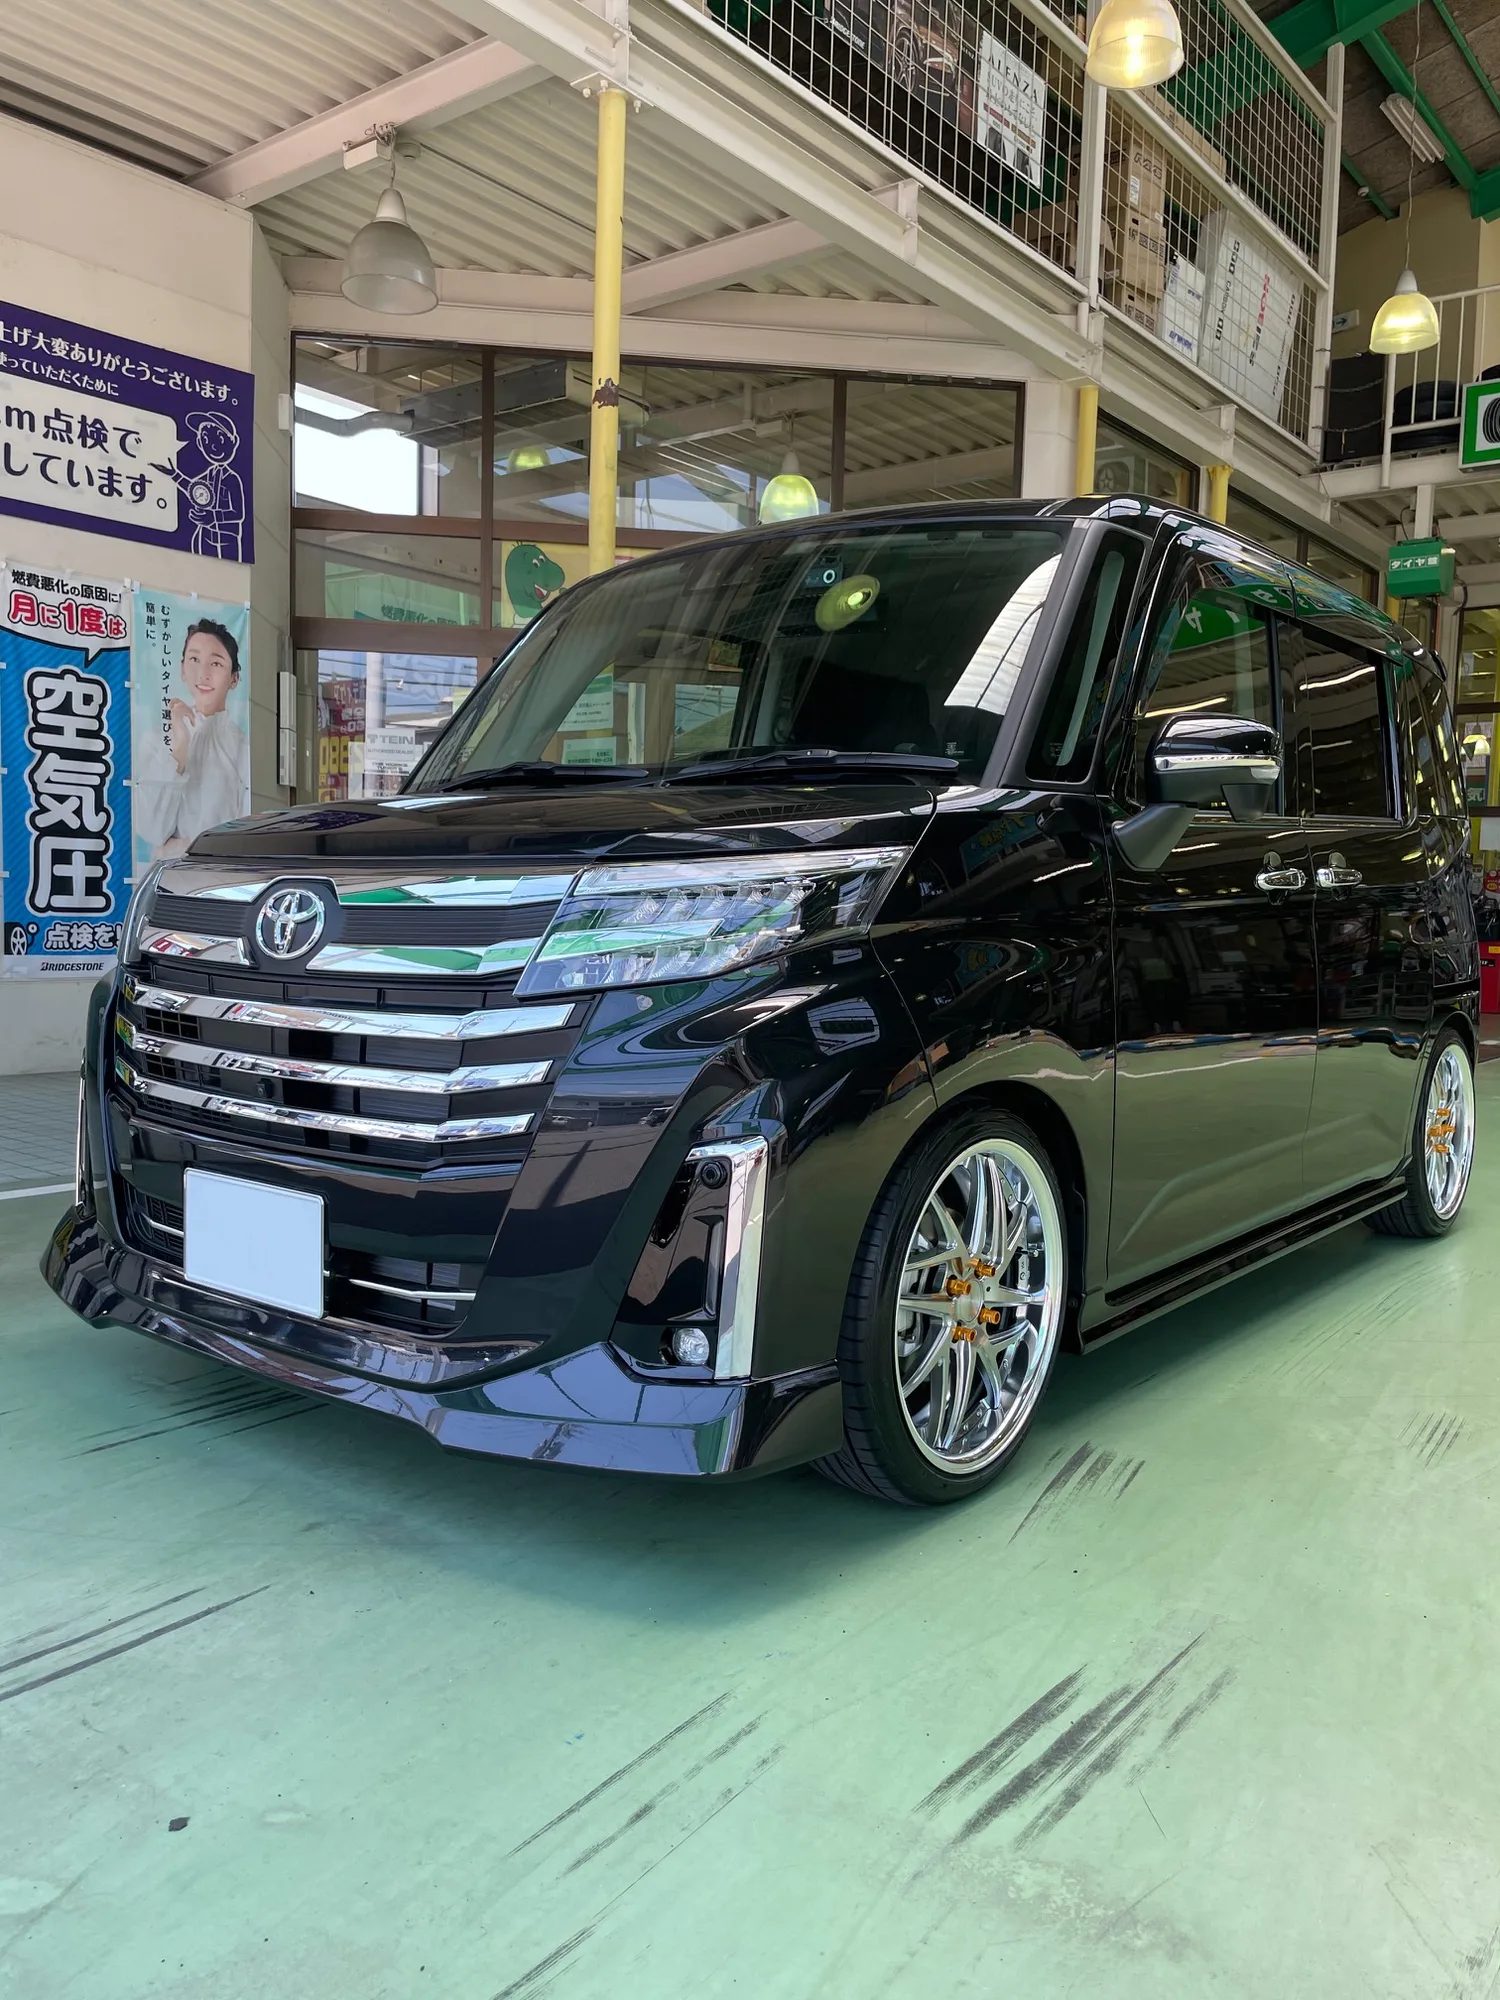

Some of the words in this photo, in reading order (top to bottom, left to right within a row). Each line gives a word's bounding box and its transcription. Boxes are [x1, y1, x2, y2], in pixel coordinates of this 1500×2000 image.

[830, 18, 865, 49] BRIDGETONE
[0, 321, 239, 406] 上げ大変ありがとうございます。
[0, 405, 142, 458] m点検で
[4, 442, 167, 509] しています。
[12, 569, 121, 603] 燃費悪化の原因に!
[10, 592, 125, 637] 月に1度は
[145, 602, 157, 647] 簡単に。
[161, 605, 173, 752] むずかしいタイヤ選びを、
[30, 671, 108, 911] 空気圧
[45, 923, 123, 950] 点検を!
[40, 962, 105, 971] BRIDGESTONE
